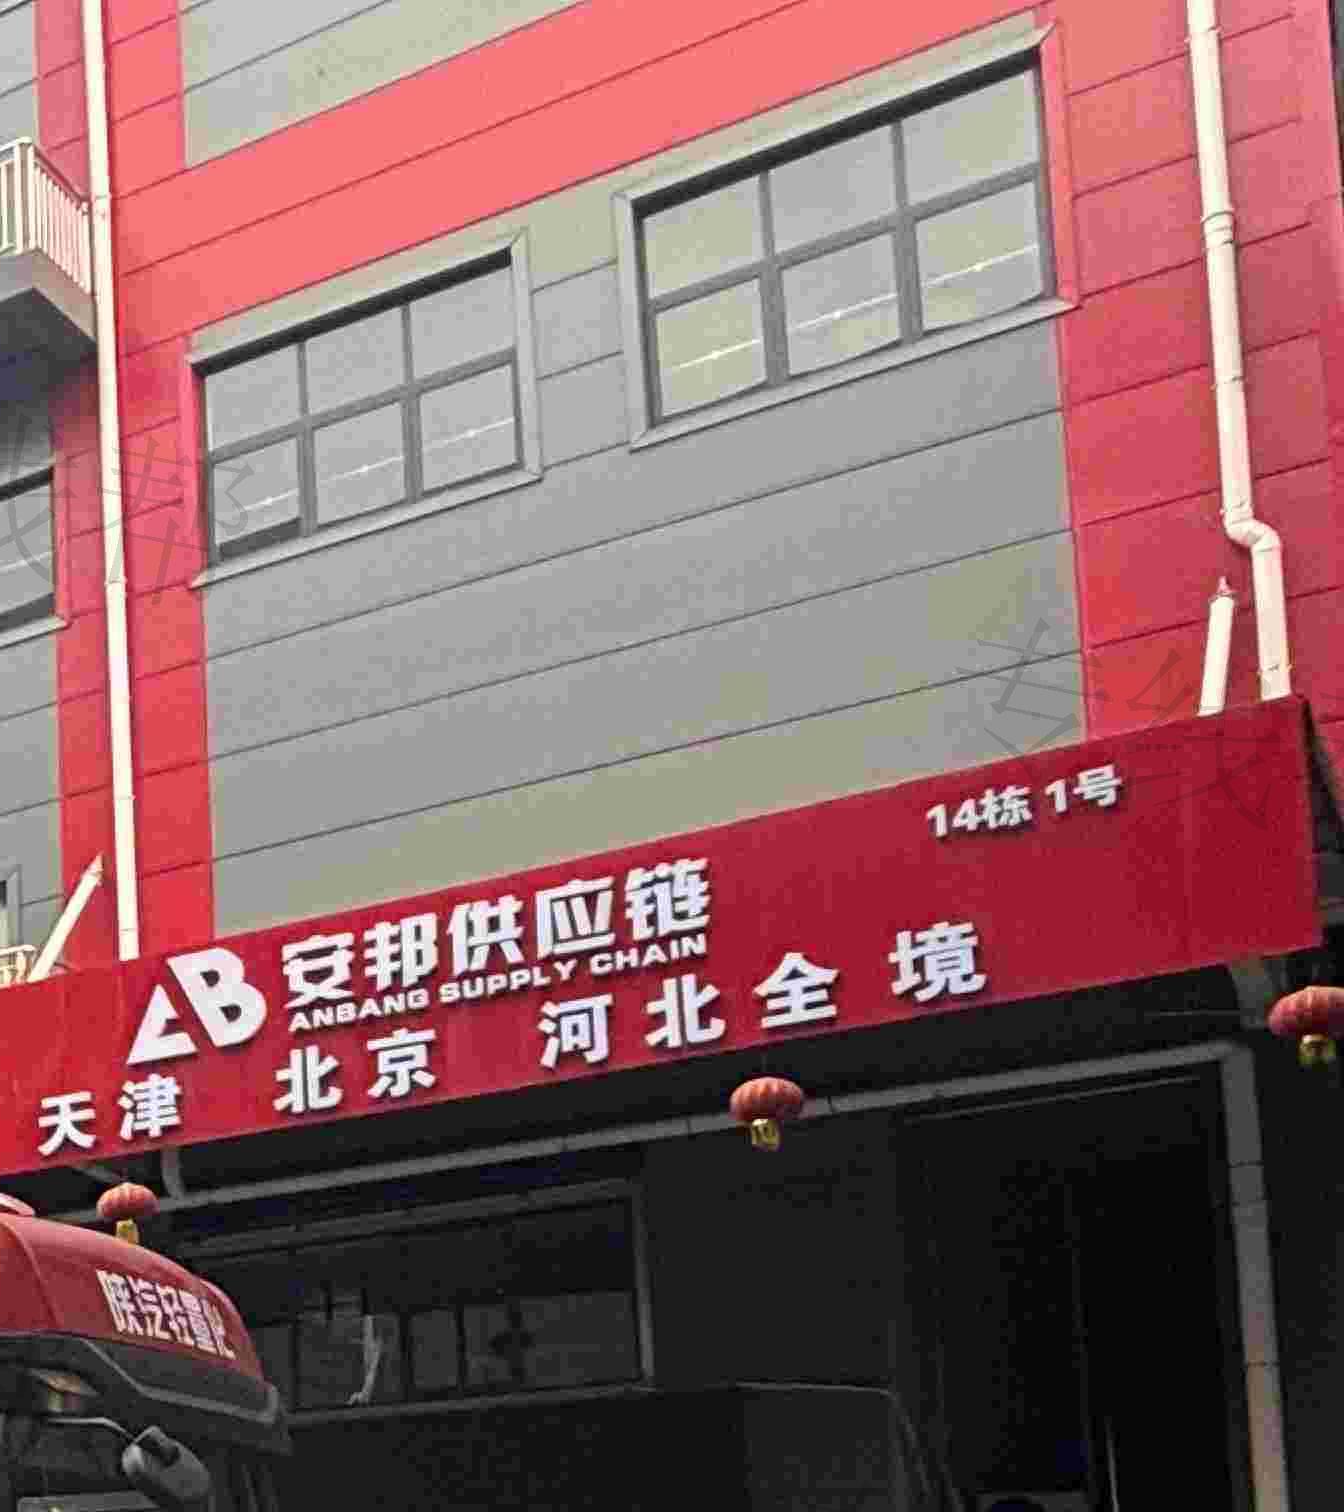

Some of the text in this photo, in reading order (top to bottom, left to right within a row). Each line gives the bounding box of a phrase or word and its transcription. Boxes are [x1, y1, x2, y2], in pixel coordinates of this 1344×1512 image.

[282, 858, 710, 1009] 安邦供应链
[289, 934, 707, 1032] ANBANG SUPPLY CHAIN
[96, 1269, 237, 1360] 陕汽轻量化
